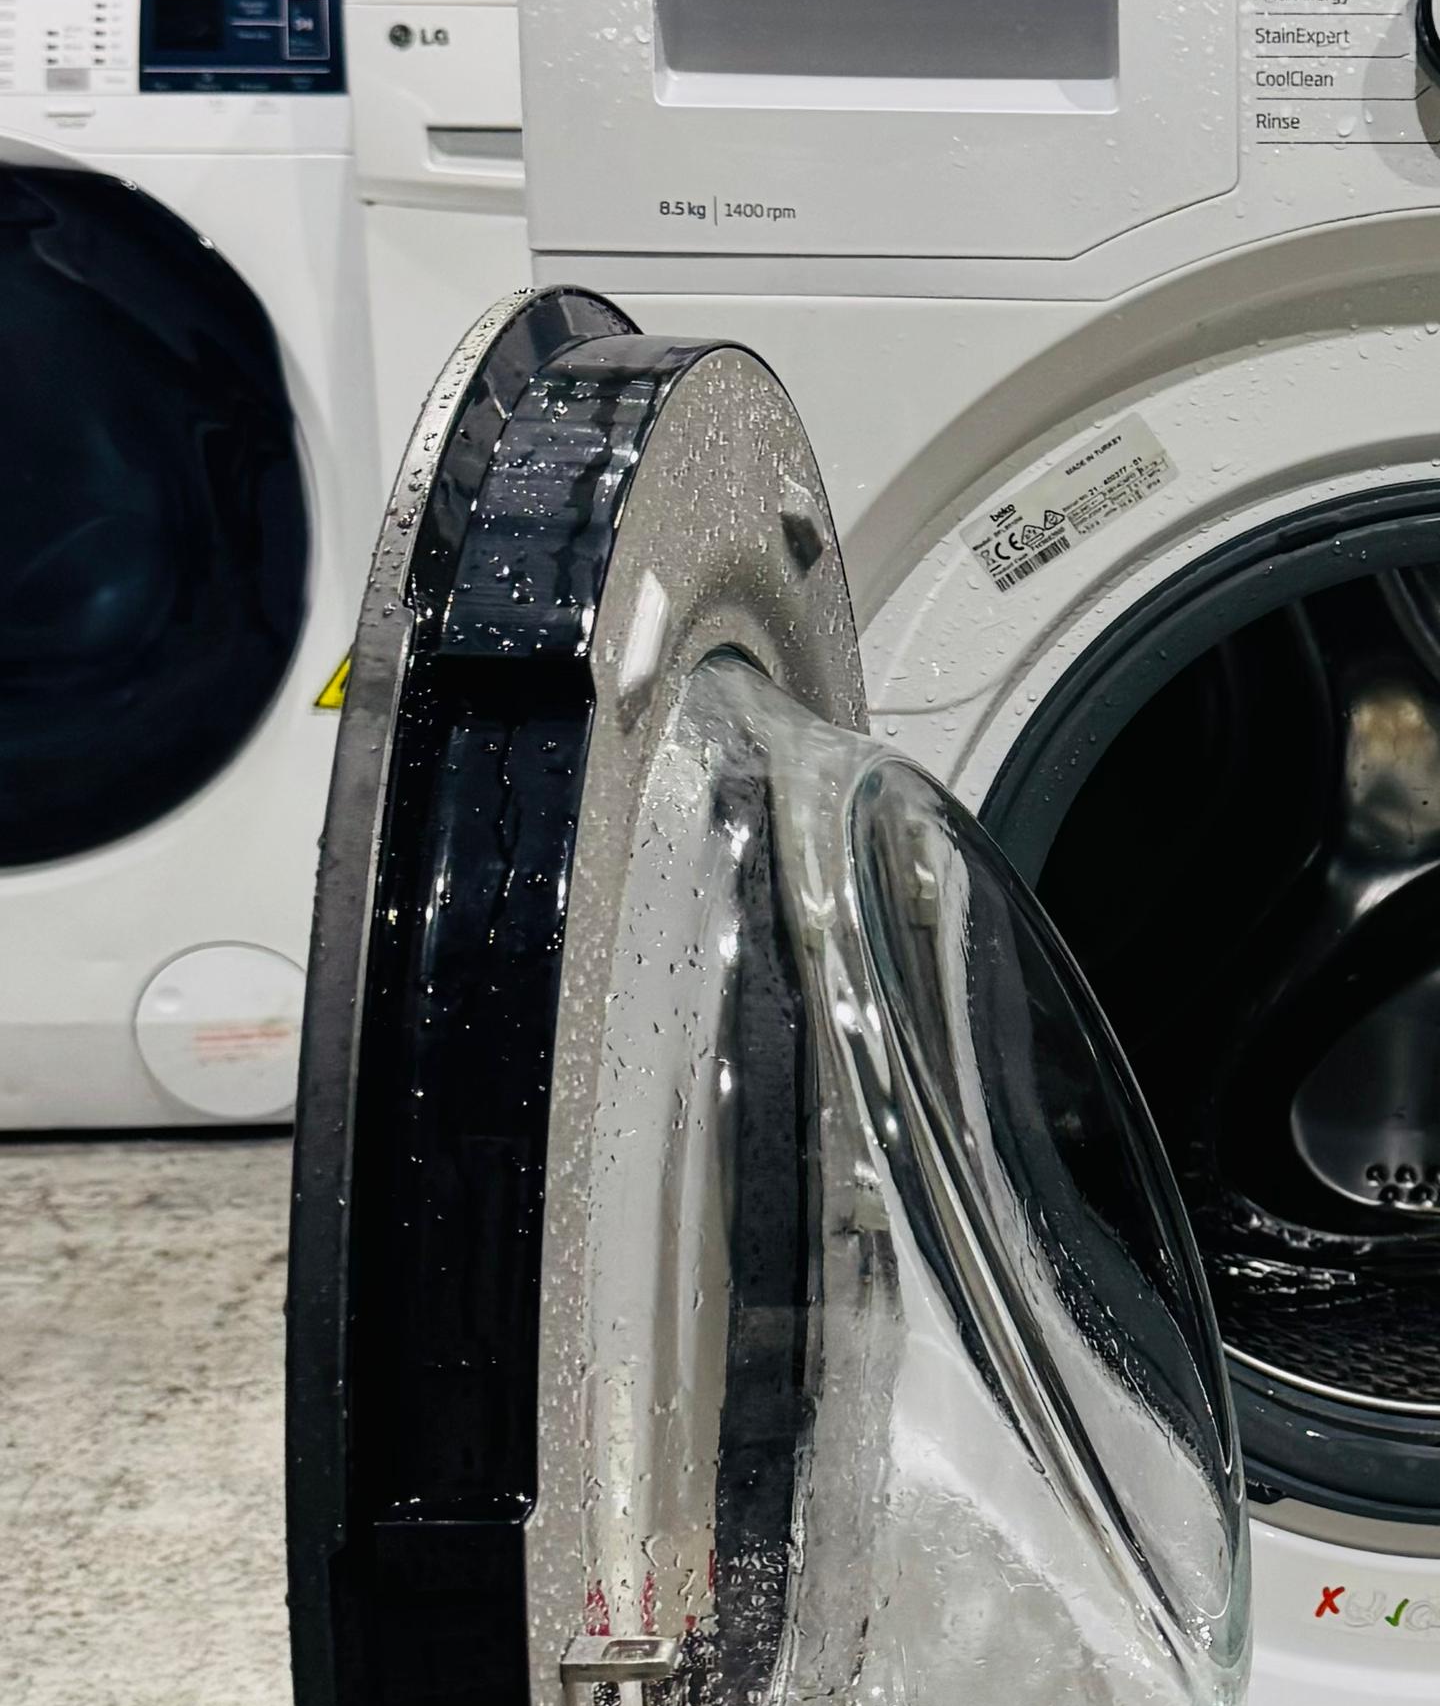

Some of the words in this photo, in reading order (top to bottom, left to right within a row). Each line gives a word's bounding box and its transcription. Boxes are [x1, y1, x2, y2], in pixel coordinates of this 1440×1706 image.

[420, 29, 449, 46] LG
[1255, 28, 1349, 48] StainExpert
[1256, 71, 1333, 87] CoolClean
[1256, 114, 1300, 129] Rinse
[659, 201, 685, 216] 8.5
[687, 202, 706, 219] kg
[725, 204, 764, 219] 1400
[767, 206, 797, 221] rpm
[1065, 459, 1086, 476] MADE
[1094, 435, 1123, 456] TURKEY
[990, 503, 1016, 523] beko
